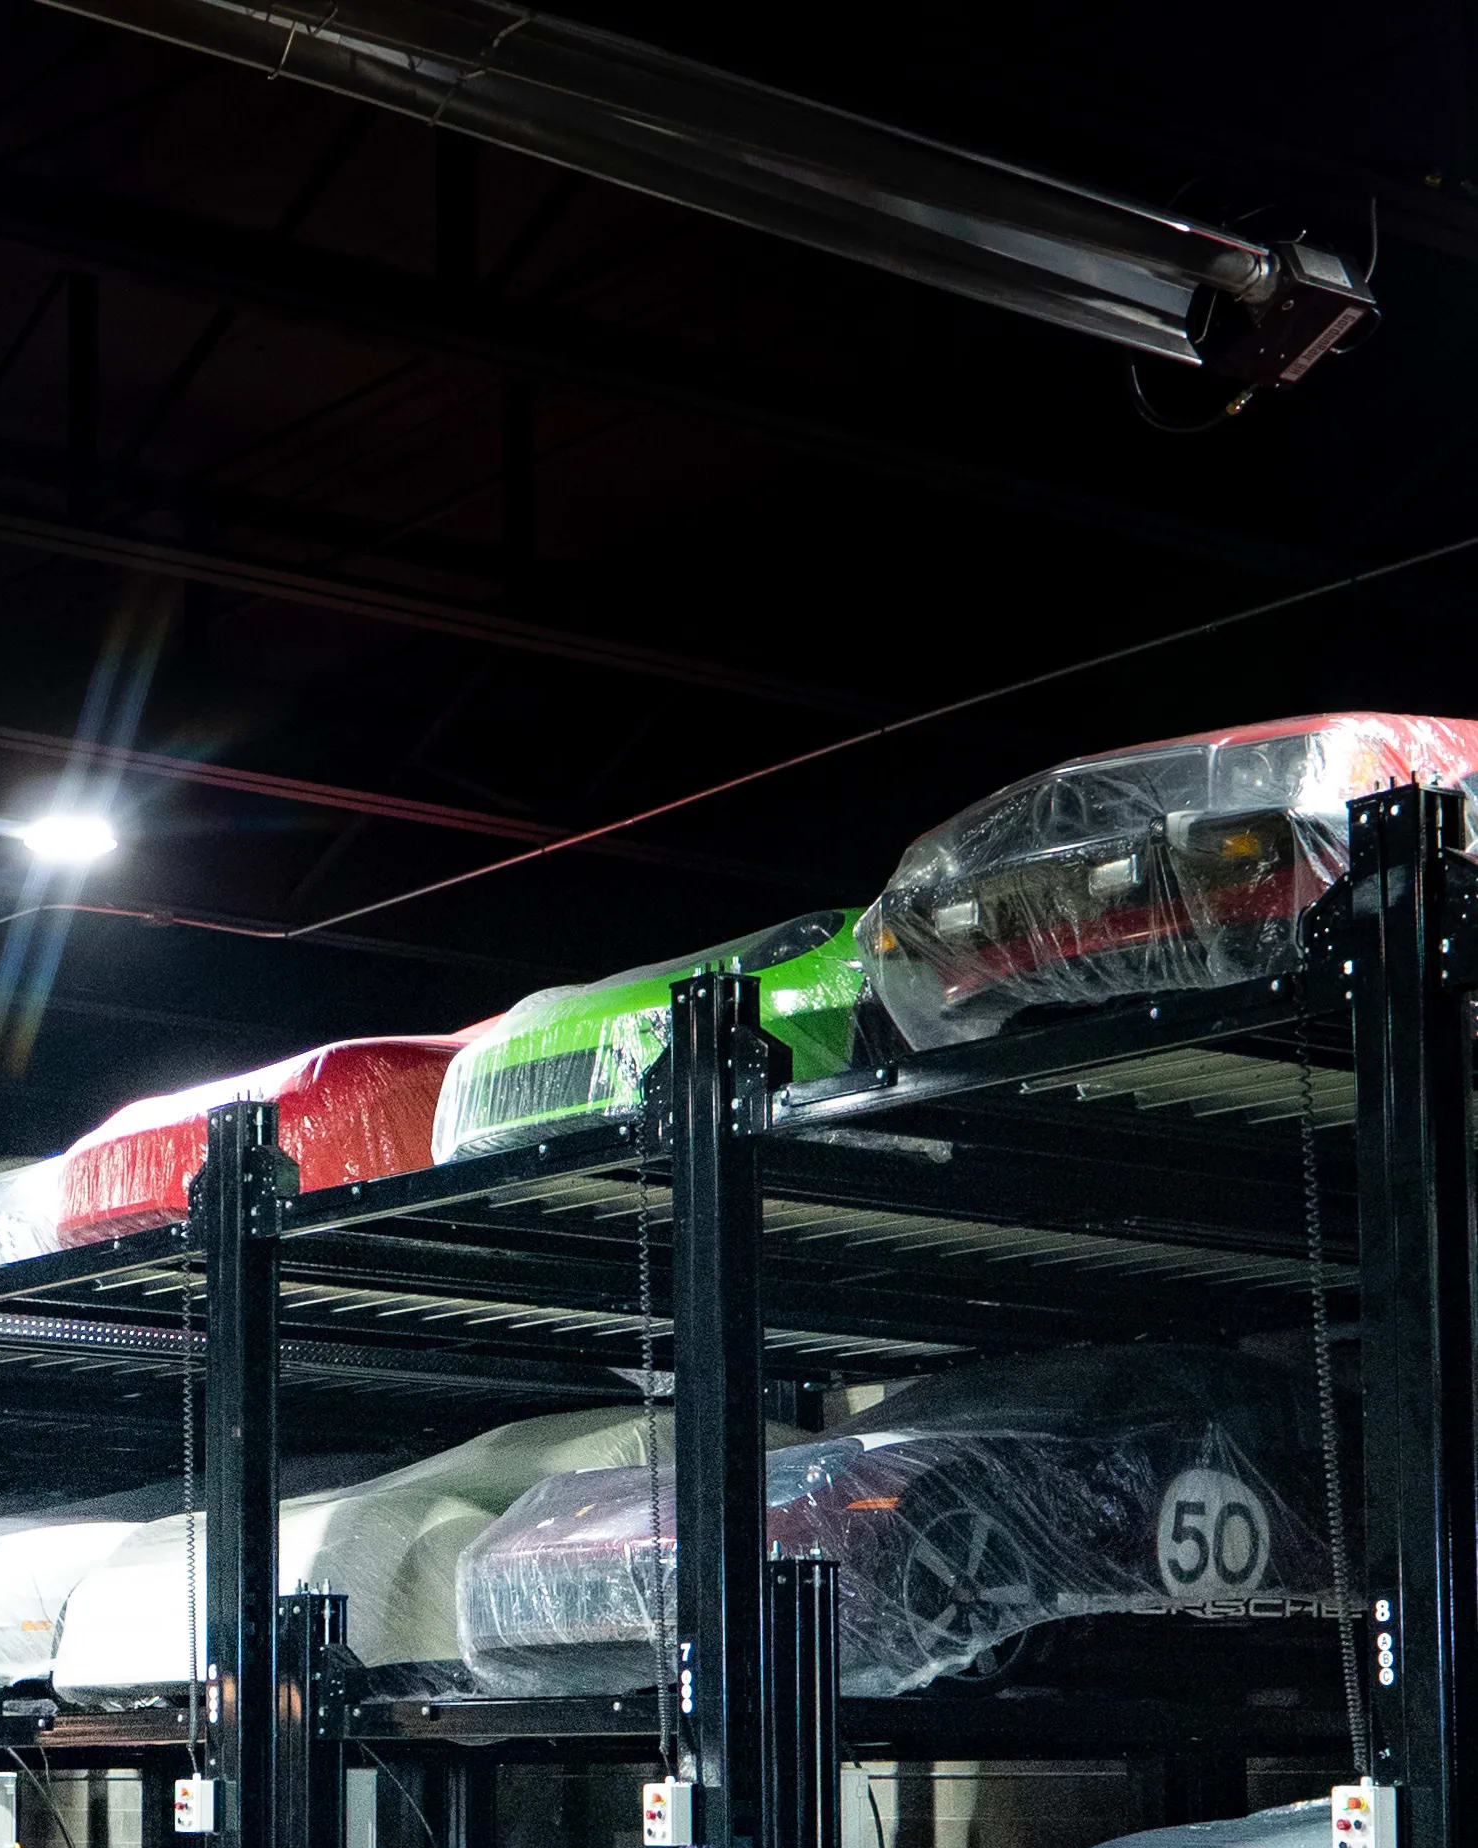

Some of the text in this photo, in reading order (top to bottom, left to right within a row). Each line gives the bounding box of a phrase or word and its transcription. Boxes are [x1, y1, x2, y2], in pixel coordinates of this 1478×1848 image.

[1167, 1500, 1260, 1585] 50
[1375, 1599, 1391, 1622] 8
[680, 1642, 692, 1662] 7
